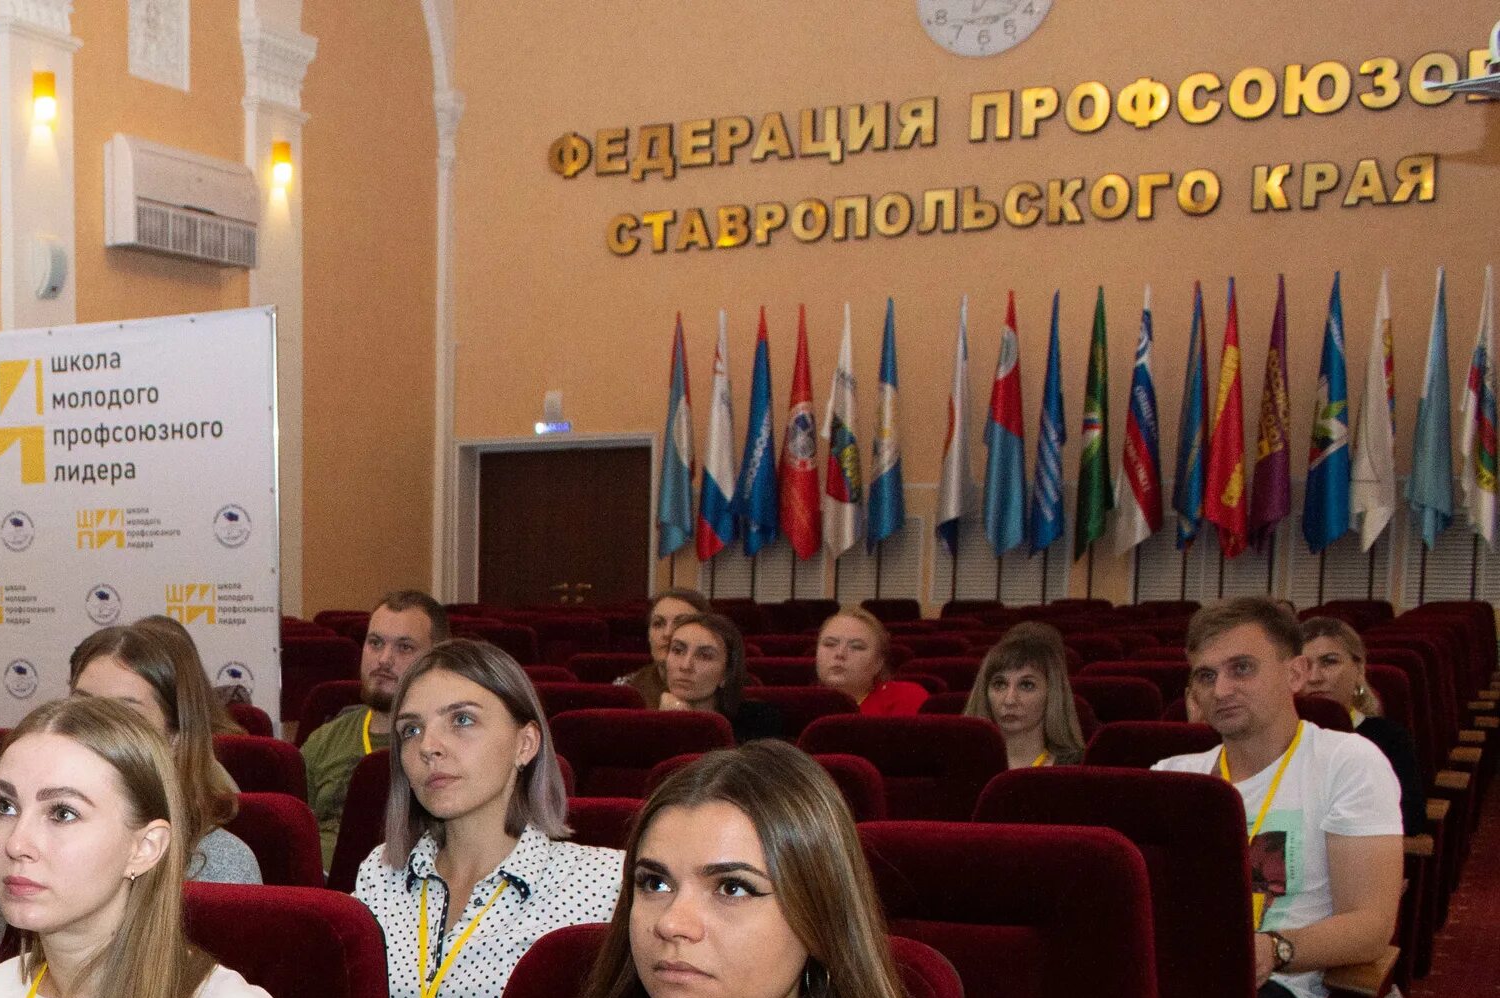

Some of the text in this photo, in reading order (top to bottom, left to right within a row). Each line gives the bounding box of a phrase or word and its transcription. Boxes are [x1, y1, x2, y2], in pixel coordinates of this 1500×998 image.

[547, 95, 938, 182] ФЕДЕРАЦИЯ
[606, 153, 1438, 257] СТАВРОПОЛЬСКОГО КРАЯ
[50, 351, 122, 373] школа
[52, 386, 160, 410] молодого
[53, 420, 224, 451] профсоюзного
[53, 462, 136, 485] лидера
